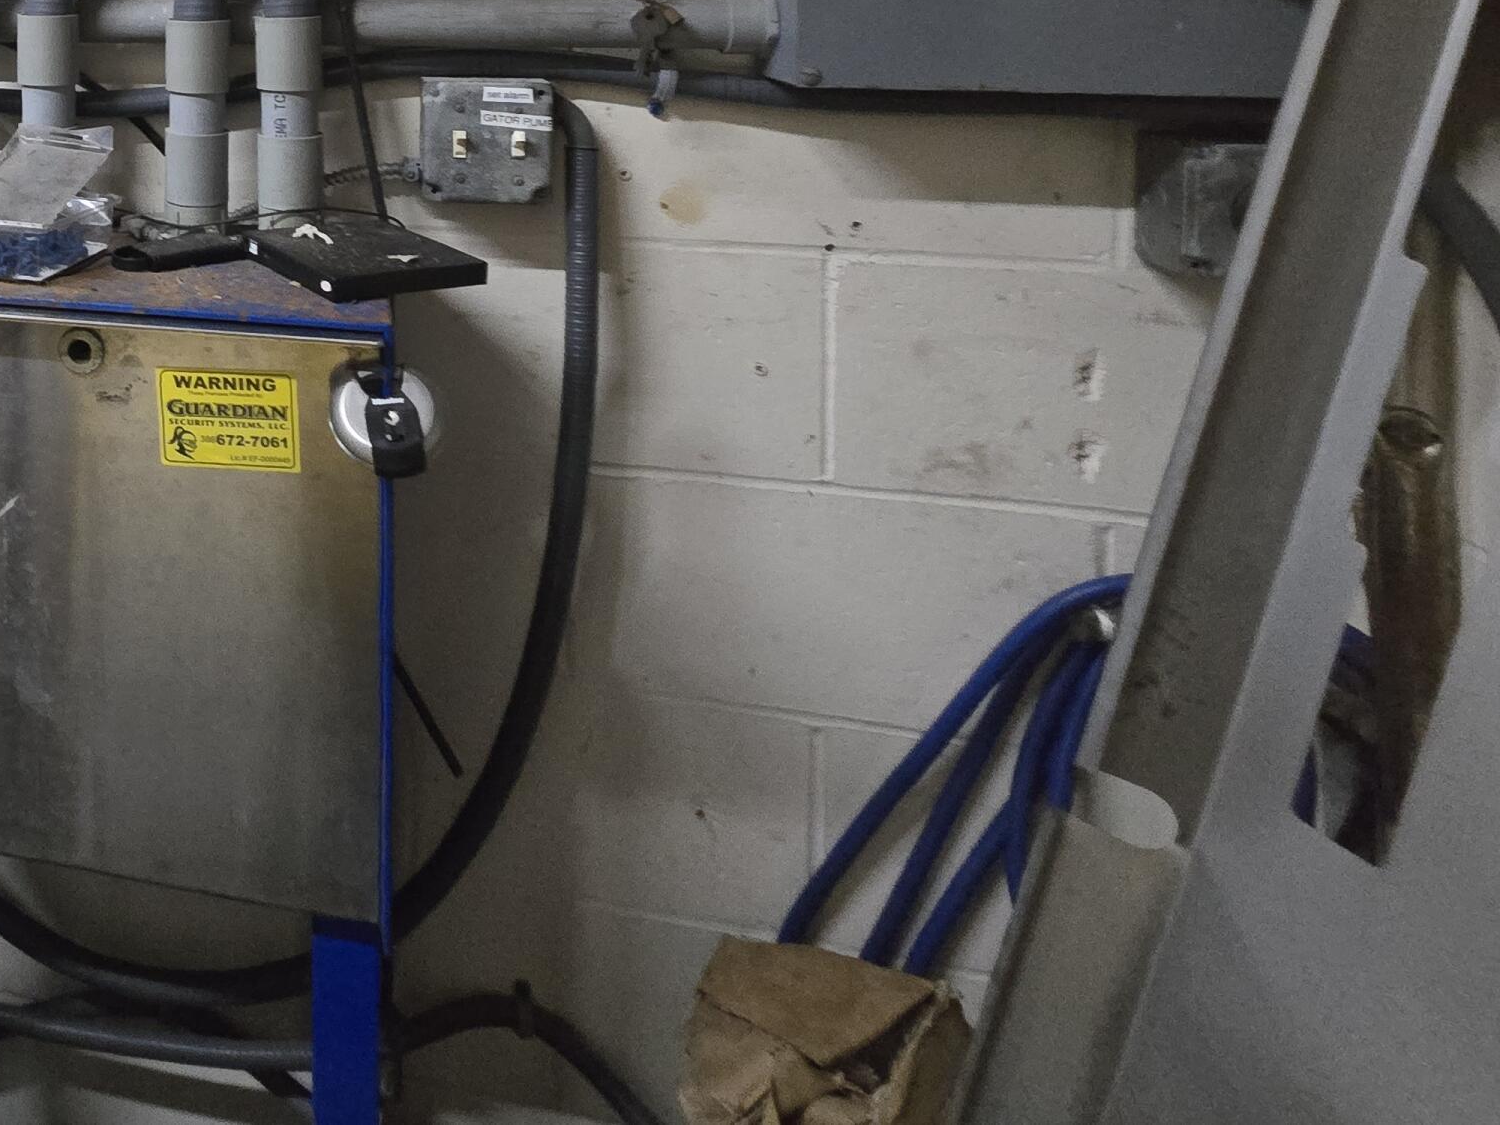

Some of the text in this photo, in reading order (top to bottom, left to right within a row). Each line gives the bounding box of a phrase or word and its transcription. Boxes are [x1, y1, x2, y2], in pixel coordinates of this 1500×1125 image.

[483, 113, 520, 124] GATOR
[173, 374, 276, 392] WARNING
[167, 398, 288, 421] GUARDIAN
[168, 417, 215, 427] SECURITY
[216, 434, 288, 448] 672-7061
